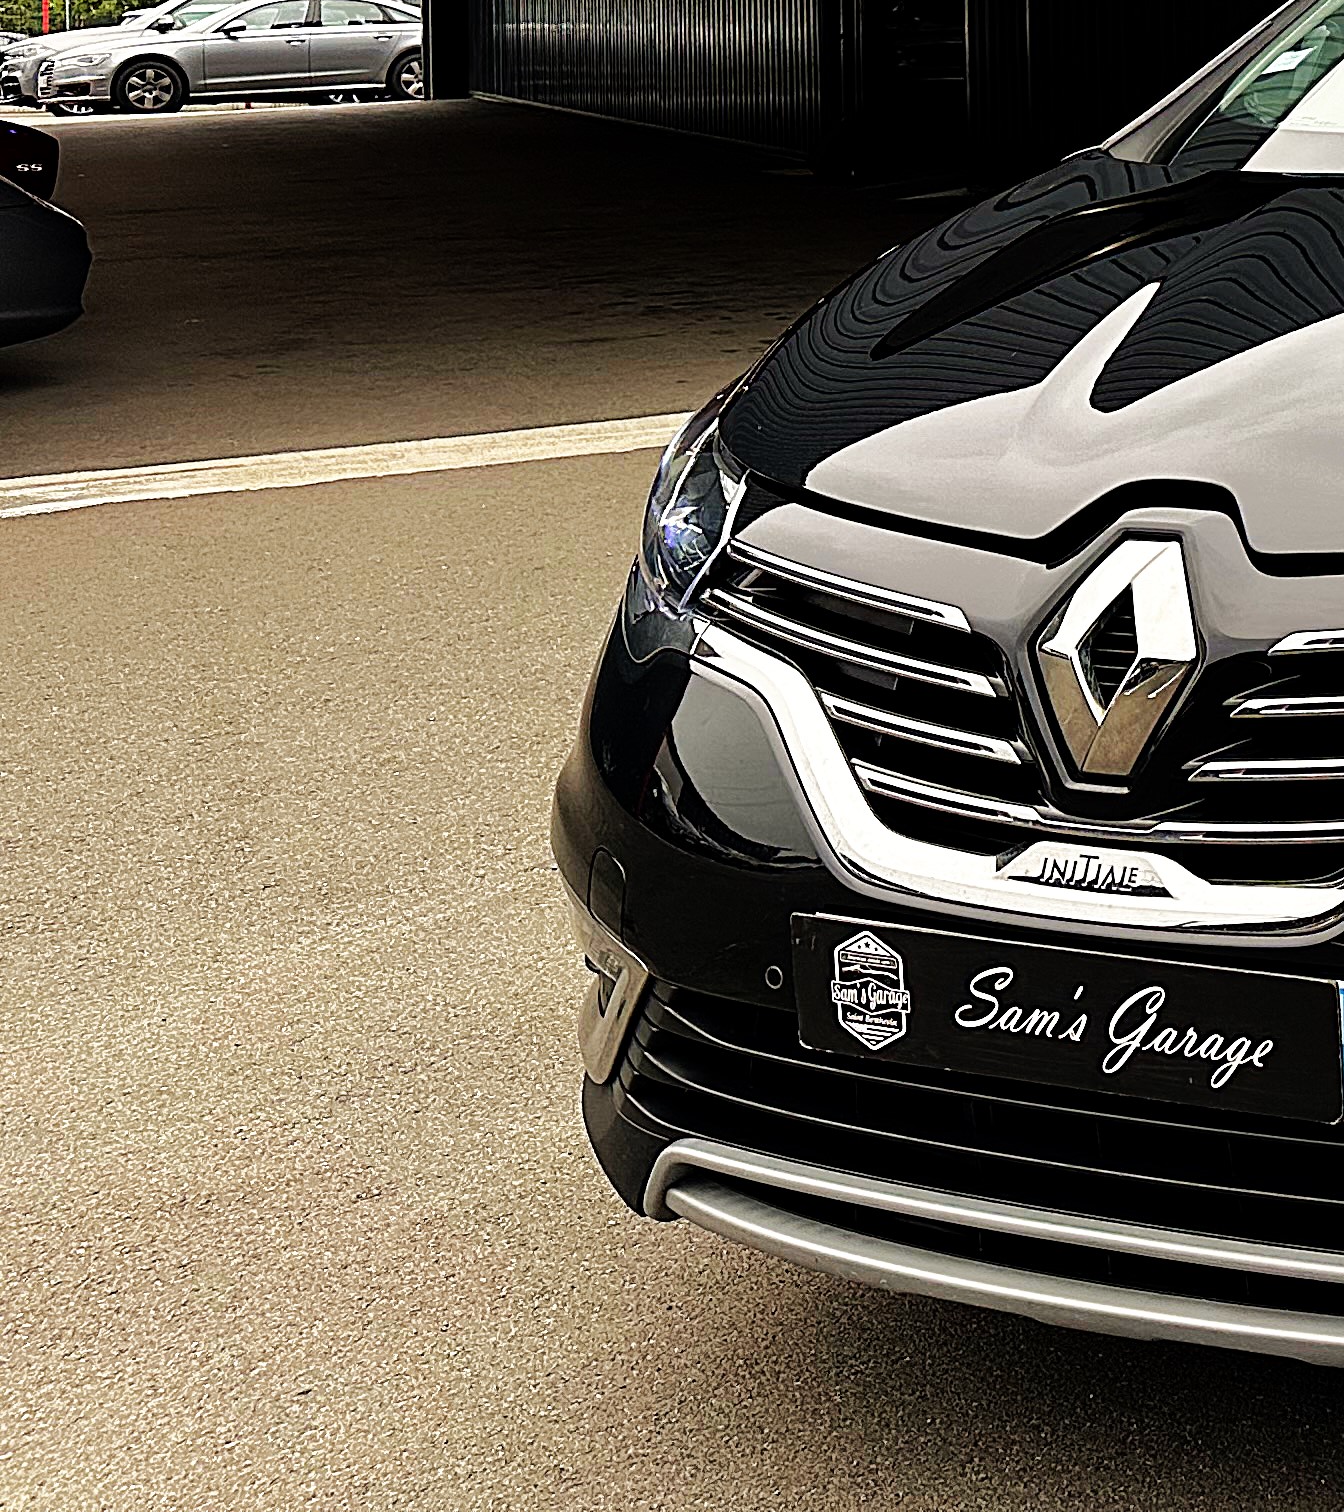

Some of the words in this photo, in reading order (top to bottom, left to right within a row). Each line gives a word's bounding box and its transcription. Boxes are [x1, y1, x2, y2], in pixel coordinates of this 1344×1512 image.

[16, 163, 43, 172] SS
[833, 982, 867, 1005] Sam's
[867, 982, 908, 1010] Garage
[954, 966, 1088, 1042] Sam's
[1101, 986, 1274, 1089] Garage
